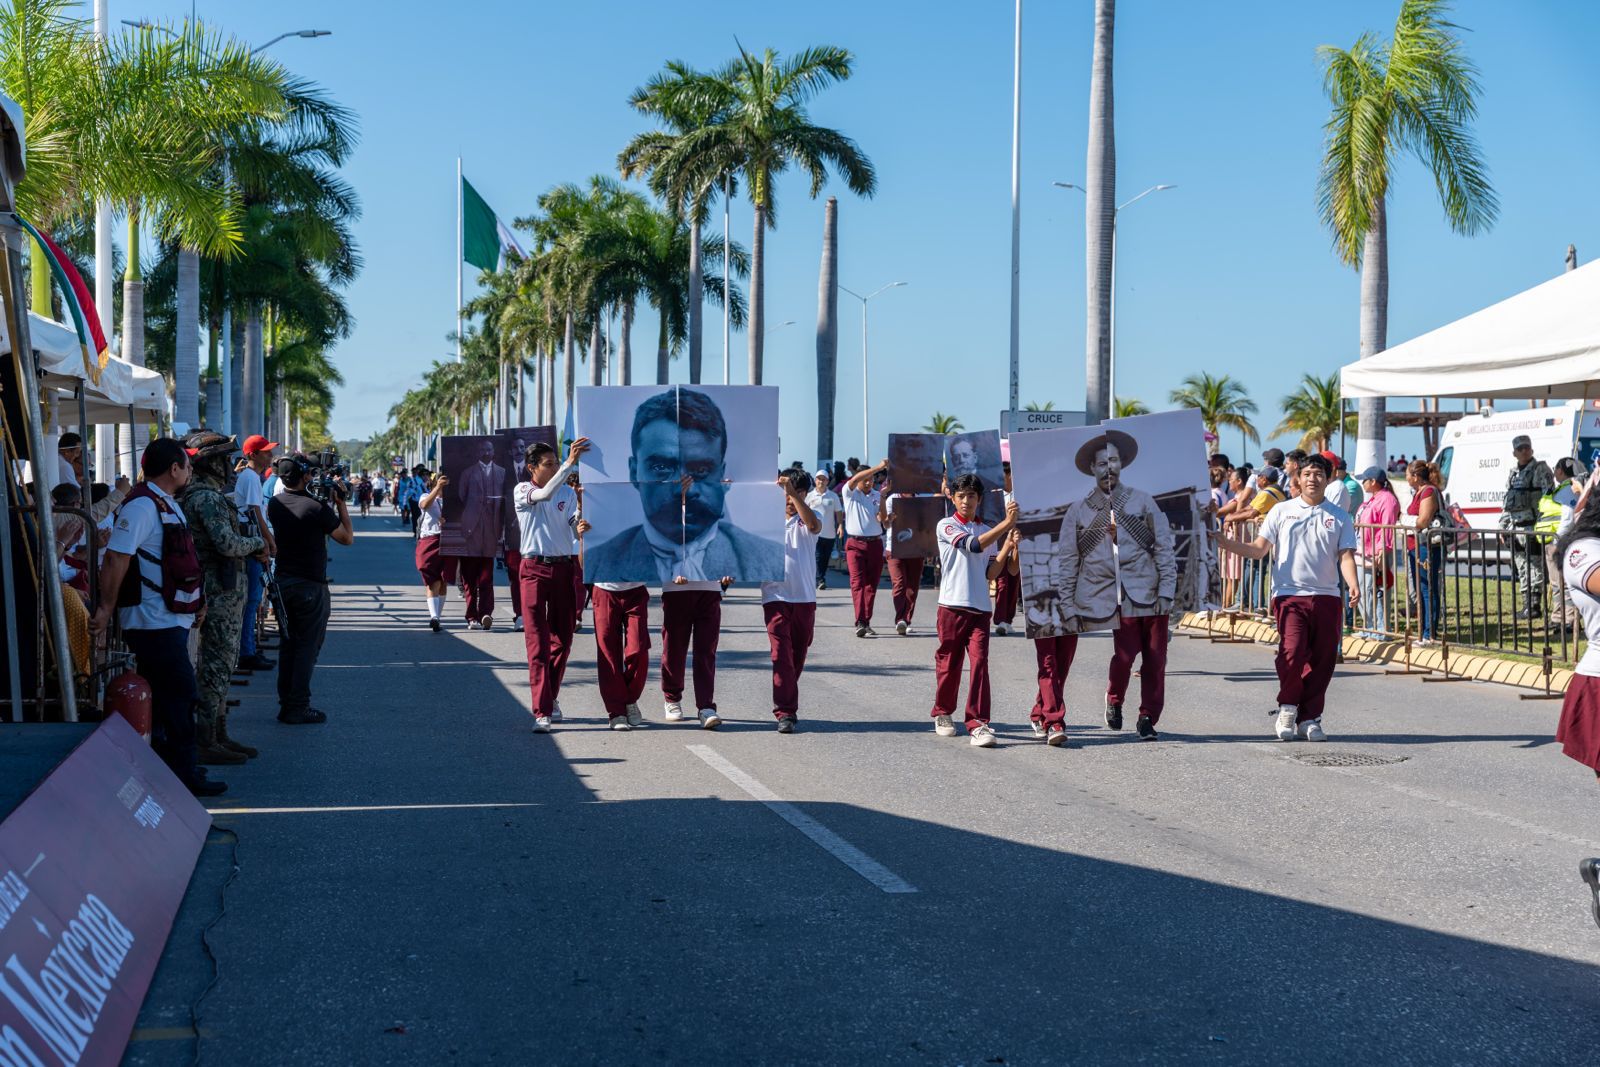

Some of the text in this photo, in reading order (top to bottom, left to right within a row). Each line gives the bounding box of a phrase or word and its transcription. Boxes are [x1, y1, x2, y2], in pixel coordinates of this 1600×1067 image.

[1027, 414, 1063, 423] CRUCE
[1479, 458, 1500, 468] SALUD
[1470, 491, 1487, 502] SAMU
